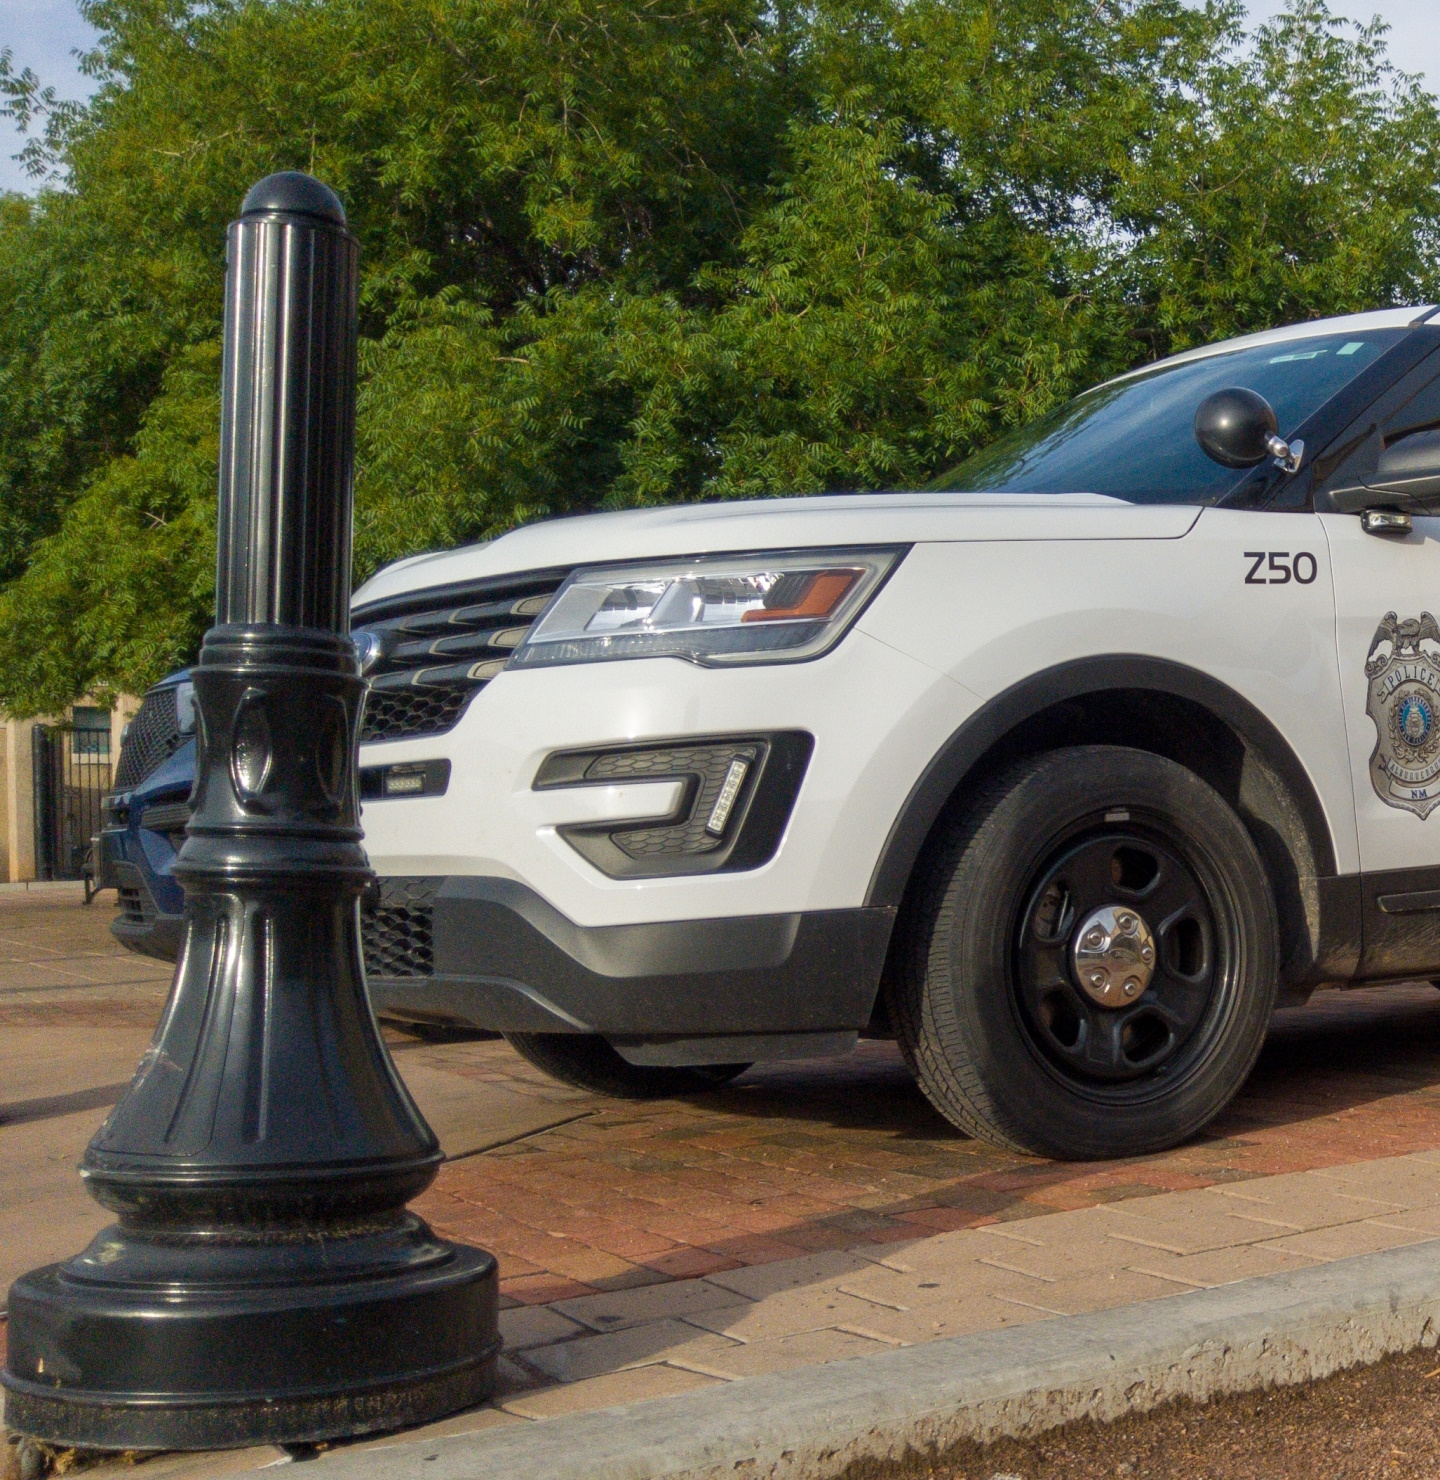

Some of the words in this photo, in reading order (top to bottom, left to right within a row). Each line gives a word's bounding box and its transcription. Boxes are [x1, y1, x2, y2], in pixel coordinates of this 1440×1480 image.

[1243, 552, 1318, 585] Z50
[1387, 666, 1435, 688] POLICE
[1411, 789, 1428, 799] NM
